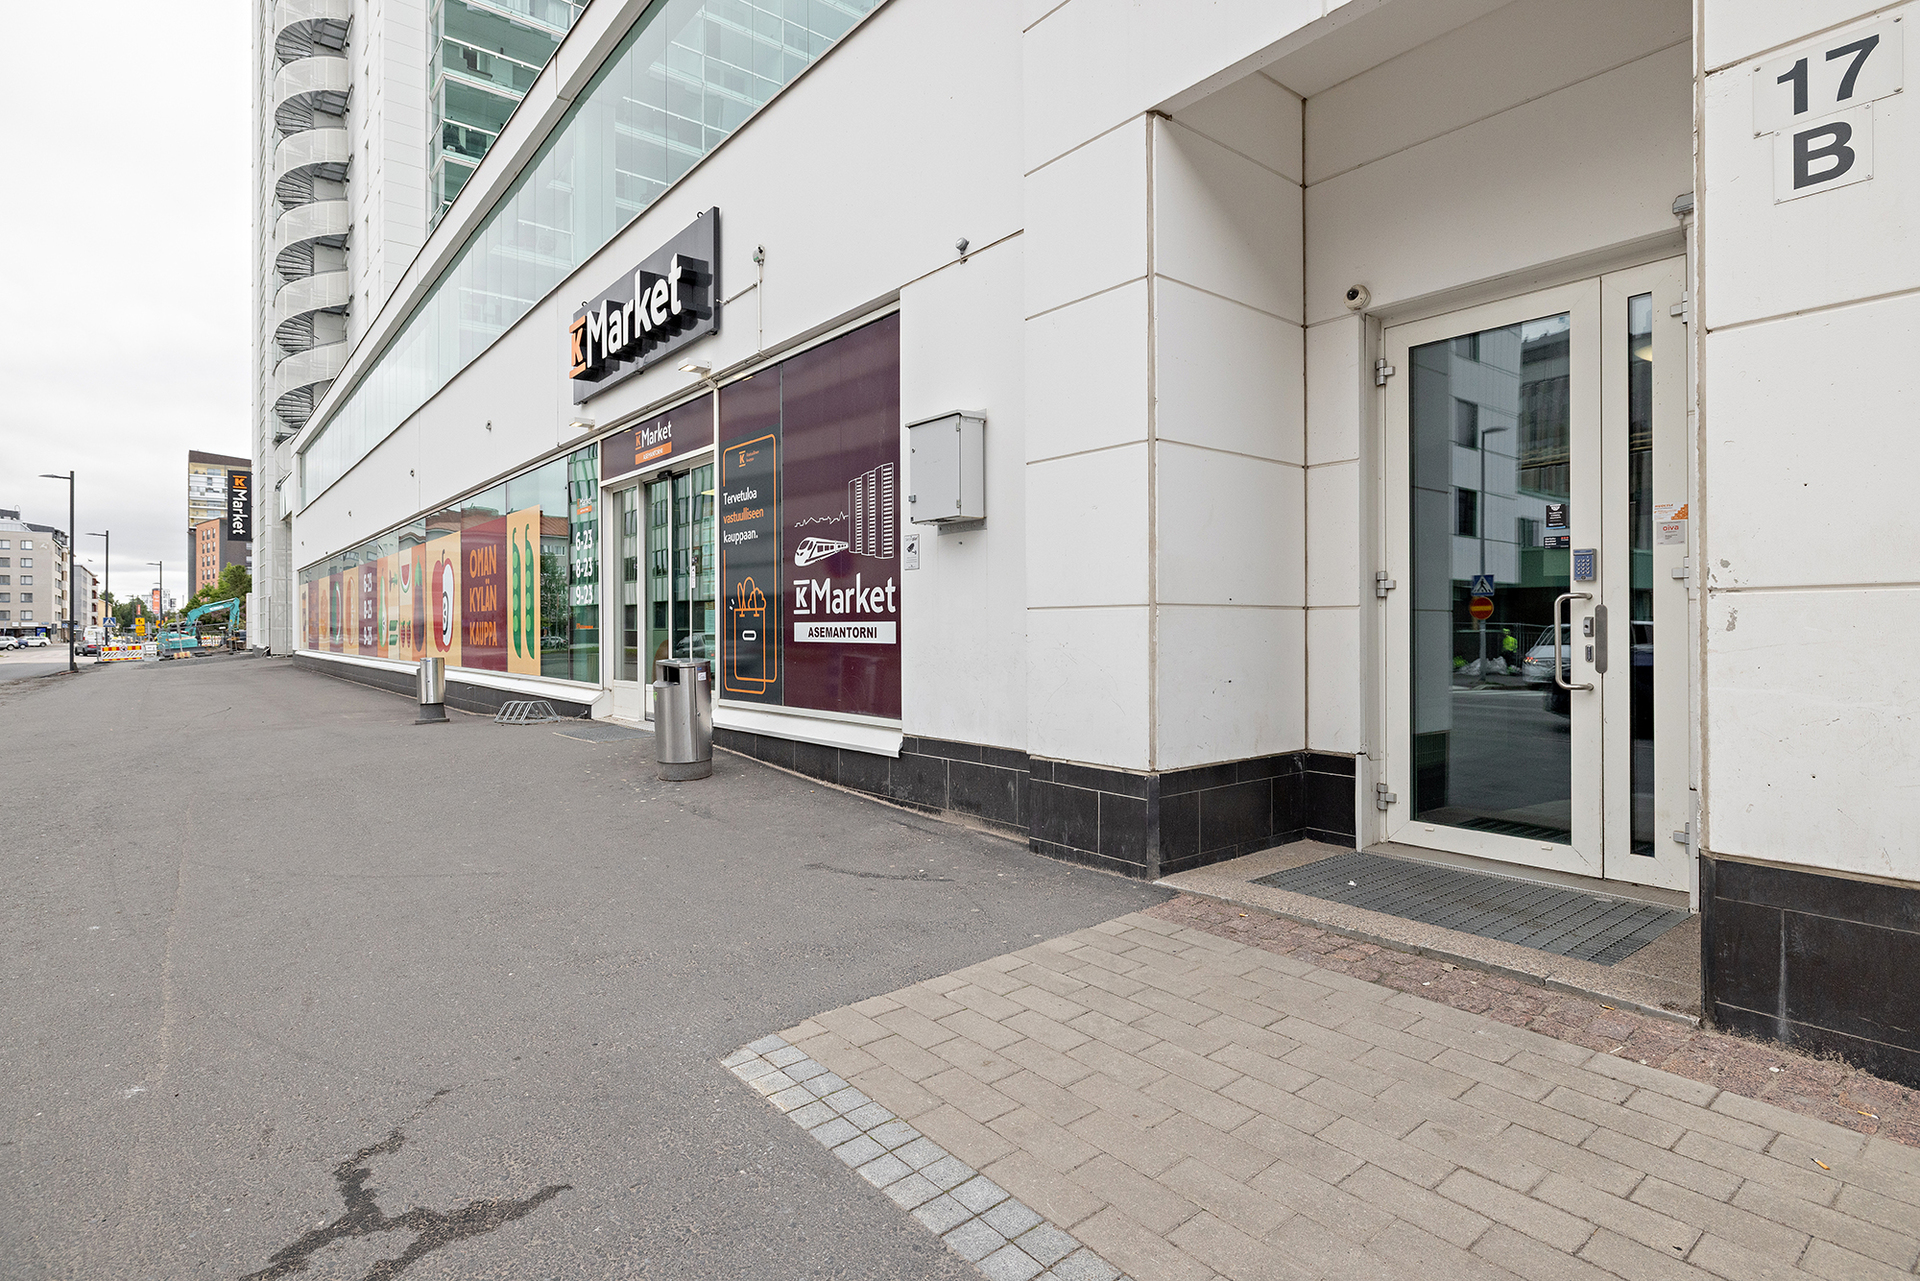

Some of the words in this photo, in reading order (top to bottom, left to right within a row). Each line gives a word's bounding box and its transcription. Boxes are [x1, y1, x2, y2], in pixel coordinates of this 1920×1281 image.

[1777, 33, 1880, 116] 17
[1793, 121, 1856, 190] B
[586, 253, 683, 368] Market
[641, 420, 672, 448] Market
[723, 487, 757, 505] Tervetuloa
[232, 489, 249, 535] Market
[723, 507, 764, 524] vastuulliseen
[575, 529, 593, 551] 6-23
[723, 528, 758, 544] kauppaan.
[469, 544, 497, 579] OMAN
[575, 557, 593, 578] 8-23
[469, 578, 497, 613] KYLÄN
[575, 584, 593, 605] 9-23
[811, 572, 896, 615] Market
[469, 621, 498, 646] KAUPPA
[807, 625, 878, 639] ASEMANTORNI
